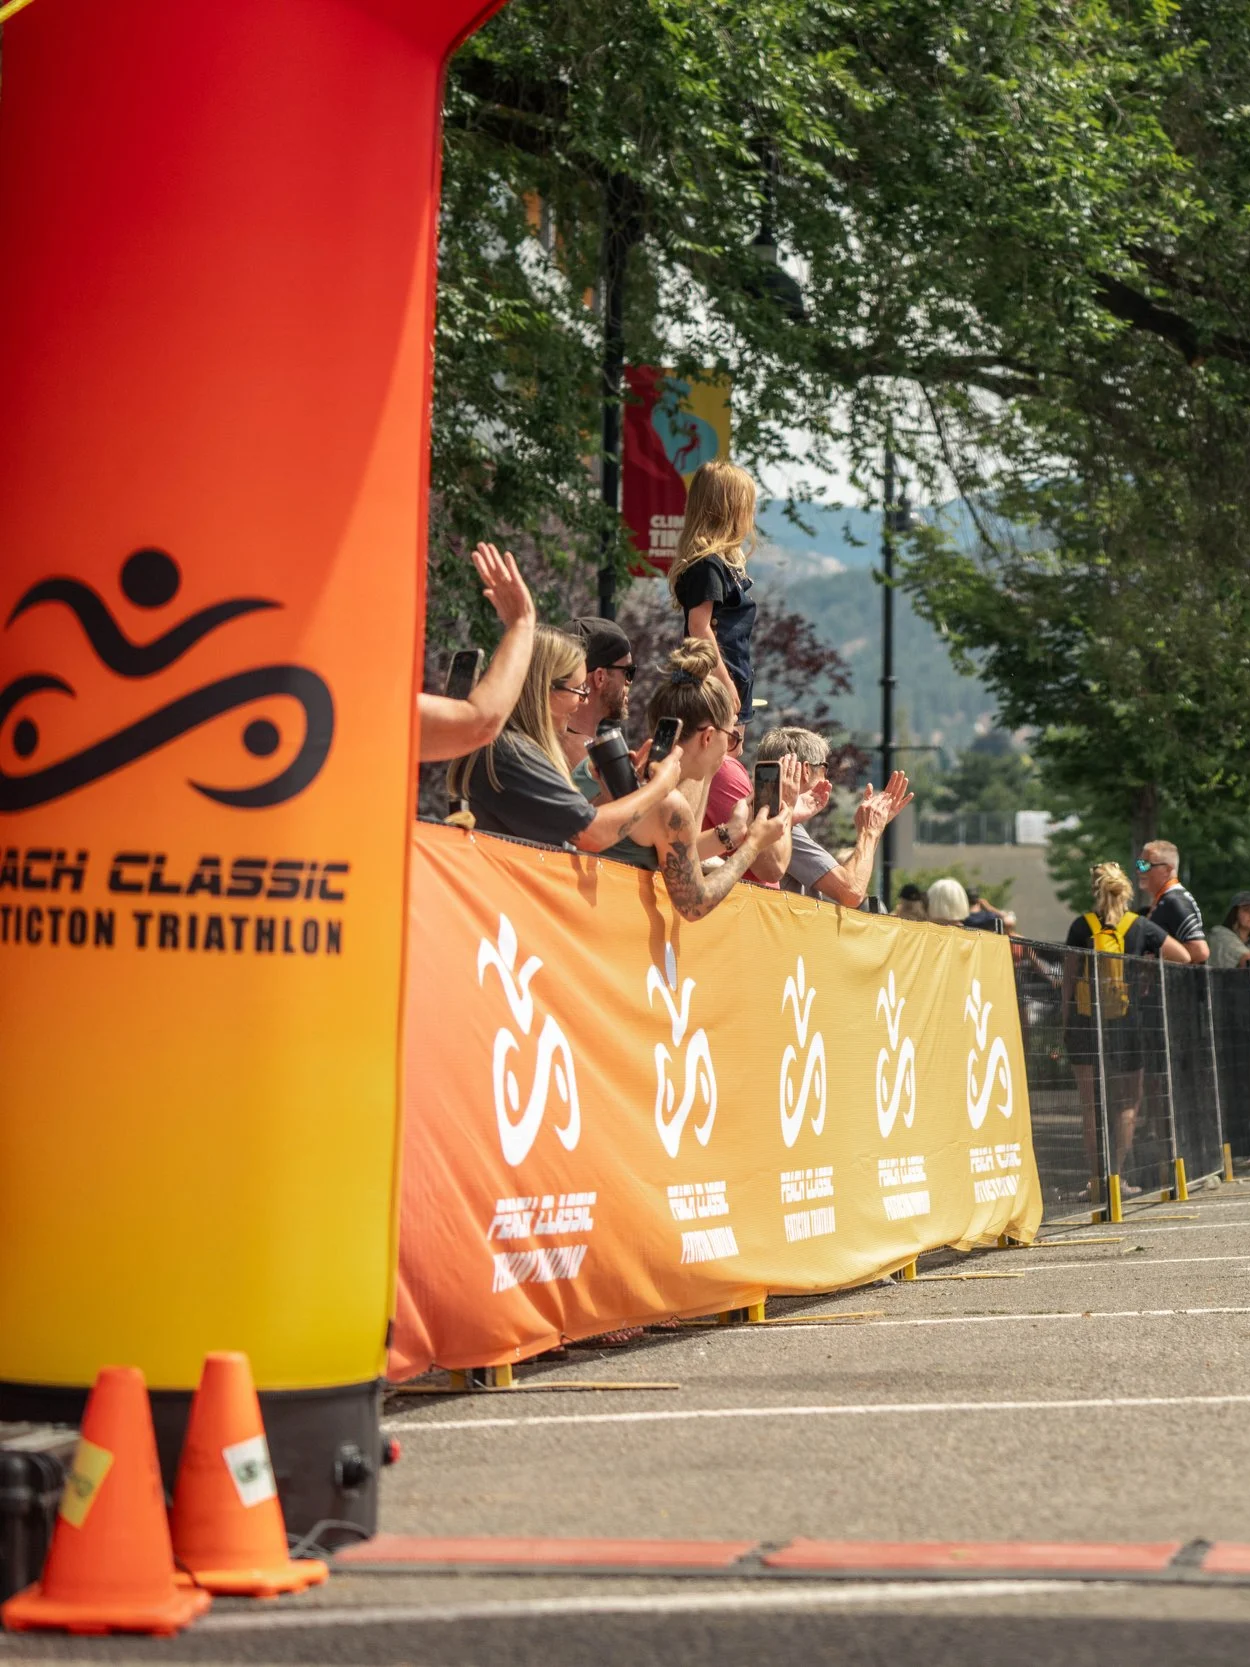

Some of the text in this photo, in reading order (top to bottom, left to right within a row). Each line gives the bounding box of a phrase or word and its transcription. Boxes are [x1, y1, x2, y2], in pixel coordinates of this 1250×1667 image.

[108, 851, 349, 901] CLASSIC
[0, 905, 343, 955] TICTON TRIATHLON
